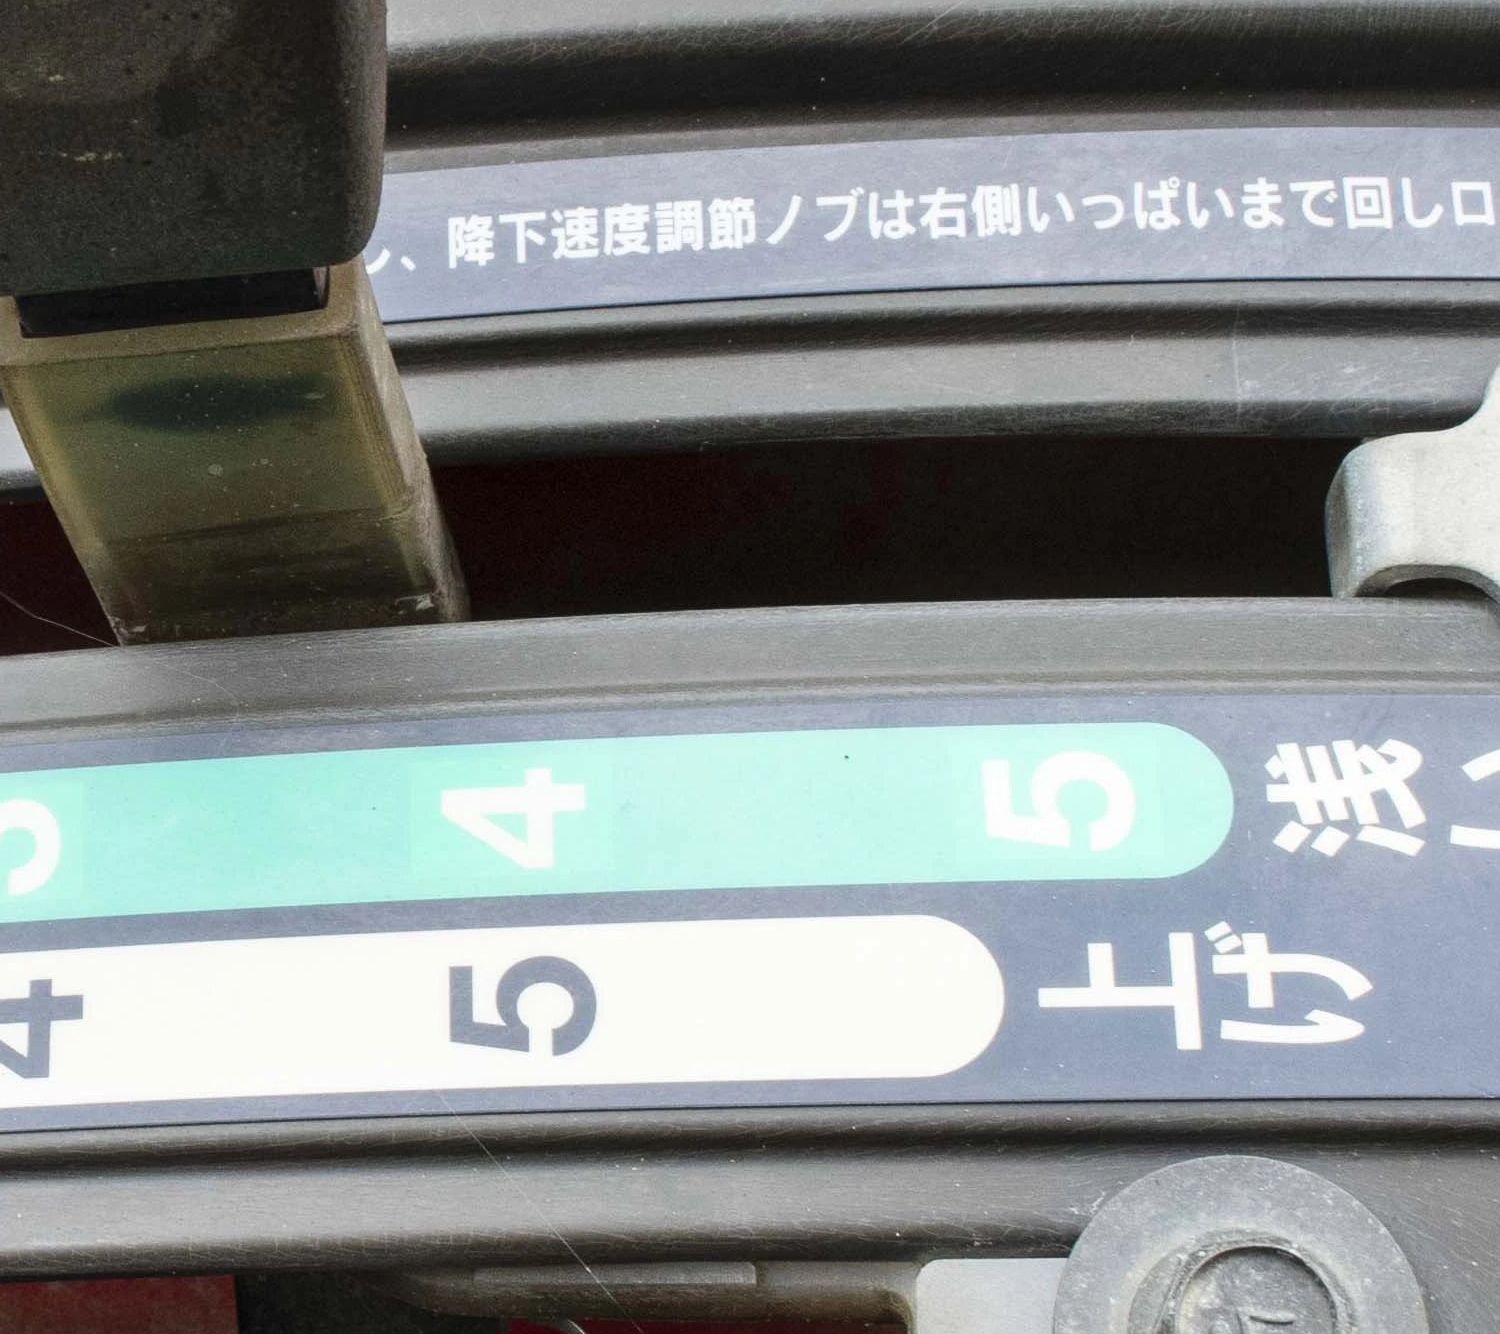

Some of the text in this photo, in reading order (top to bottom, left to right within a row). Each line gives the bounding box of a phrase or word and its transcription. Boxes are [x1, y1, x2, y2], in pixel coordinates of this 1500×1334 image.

[441, 767, 586, 869] 4
[981, 749, 1136, 852] 5
[449, 955, 597, 1058] 5
[1038, 921, 1373, 1050] 上げ
